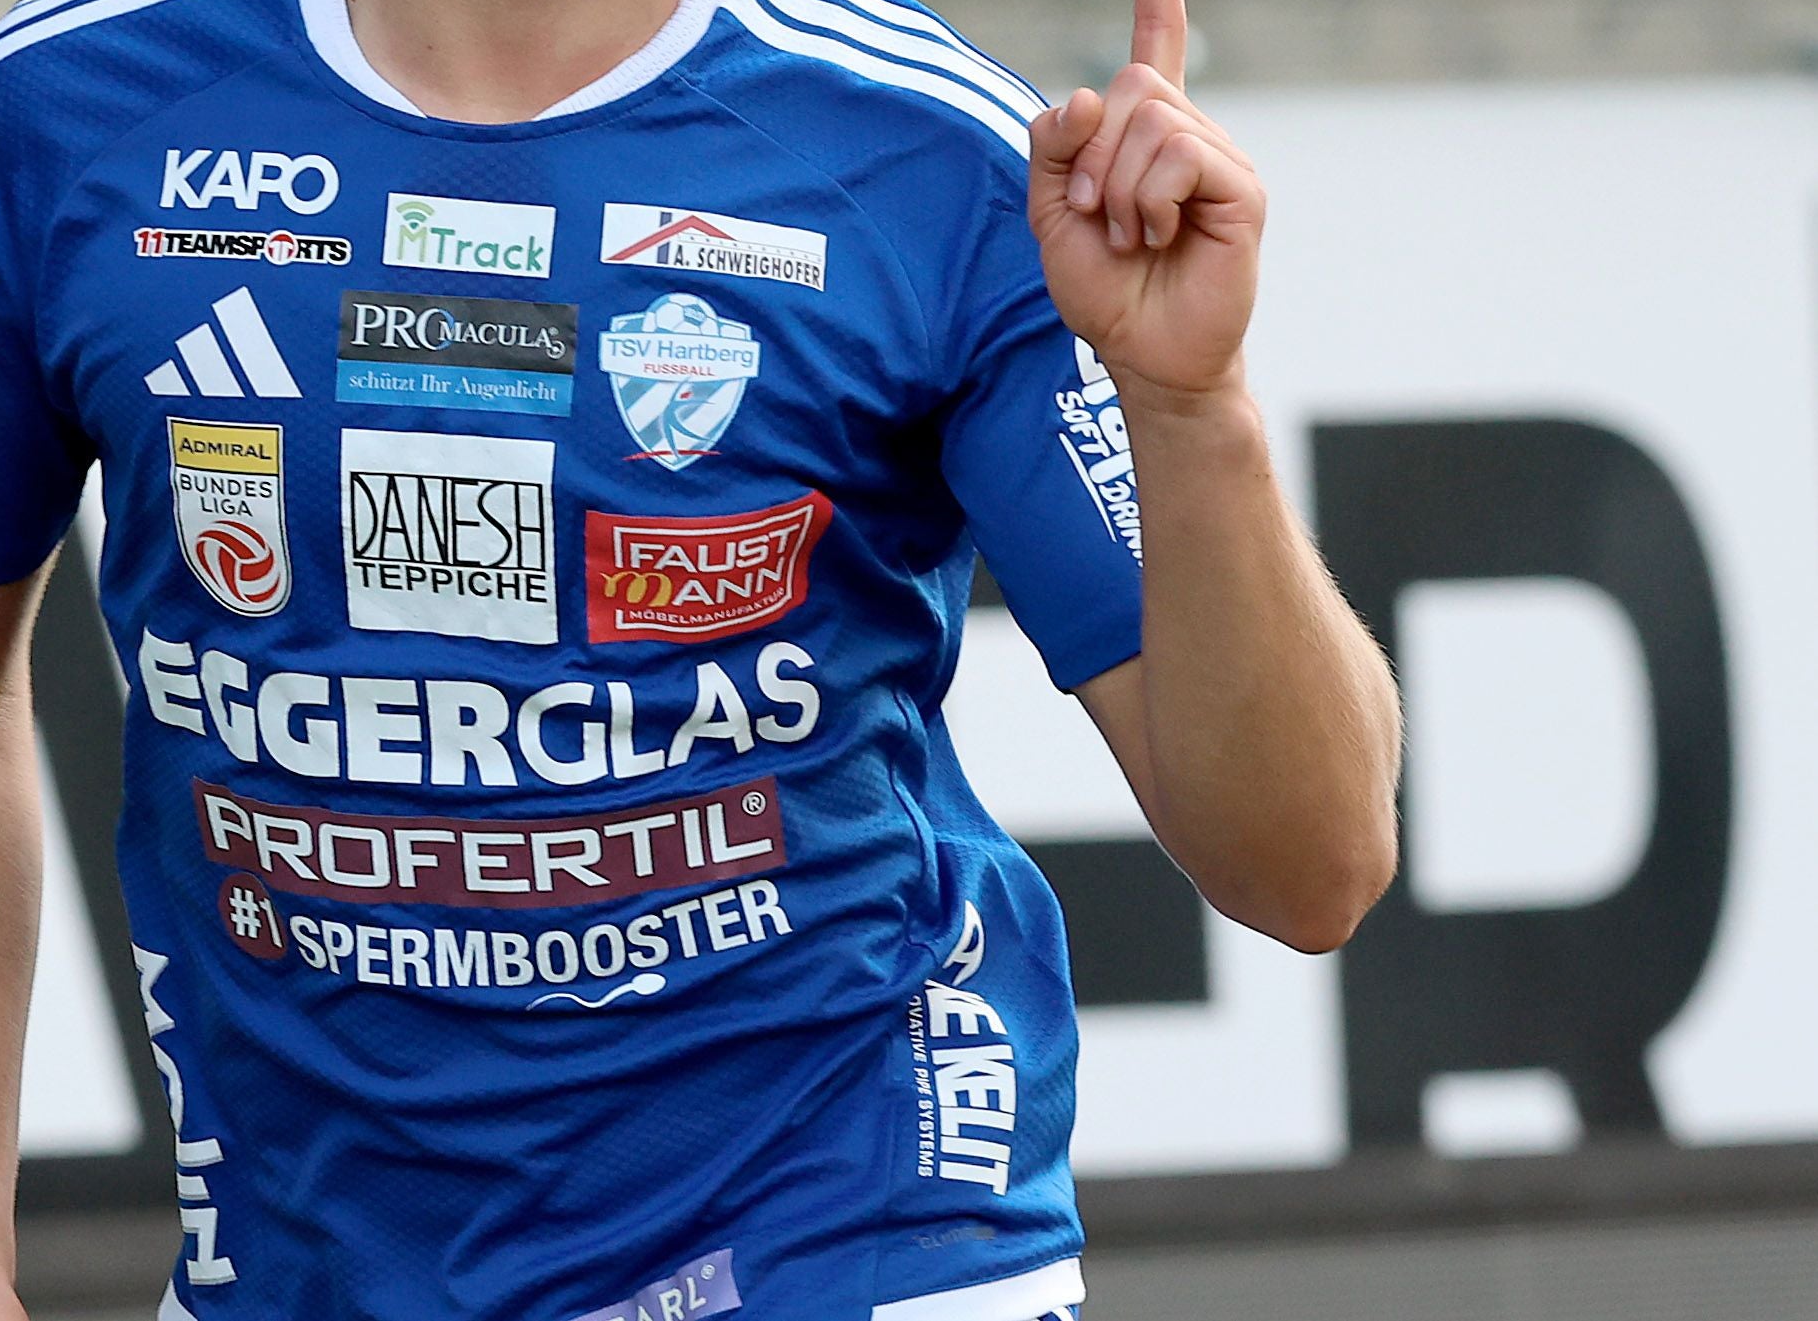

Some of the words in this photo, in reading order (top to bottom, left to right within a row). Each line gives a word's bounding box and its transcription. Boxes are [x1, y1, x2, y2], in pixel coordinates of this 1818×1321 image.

[159, 149, 340, 215] KAPO
[396, 223, 544, 272] MTrack
[673, 244, 690, 267] A.
[697, 247, 821, 289] SCHWEIGHOFER
[607, 337, 652, 358] TSV
[657, 339, 755, 368] Hartberg
[643, 362, 716, 377] FUSSBALL
[349, 370, 416, 392] schützt
[421, 373, 452, 394] Ihr
[454, 377, 558, 403] Augenlicht
[1054, 389, 1112, 458] SOFT
[178, 436, 273, 461] ADMIRAL
[179, 472, 273, 499] BUNDES
[199, 495, 254, 518] LIGA
[349, 470, 547, 573] DANESH
[1099, 480, 1144, 568] DRIN
[629, 522, 802, 574] FAUST
[352, 561, 548, 604] TEPPICHE
[628, 585, 786, 625] MÖBELMANUFAKTUR
[137, 625, 821, 787] EGGERGLAS
[227, 885, 284, 948] #1
[289, 879, 794, 989] SPERMBOOSTER
[913, 1067, 931, 1097] PIPE
[917, 1098, 935, 1179] SYSTEMS
[931, 1044, 1016, 1196] KELIT
